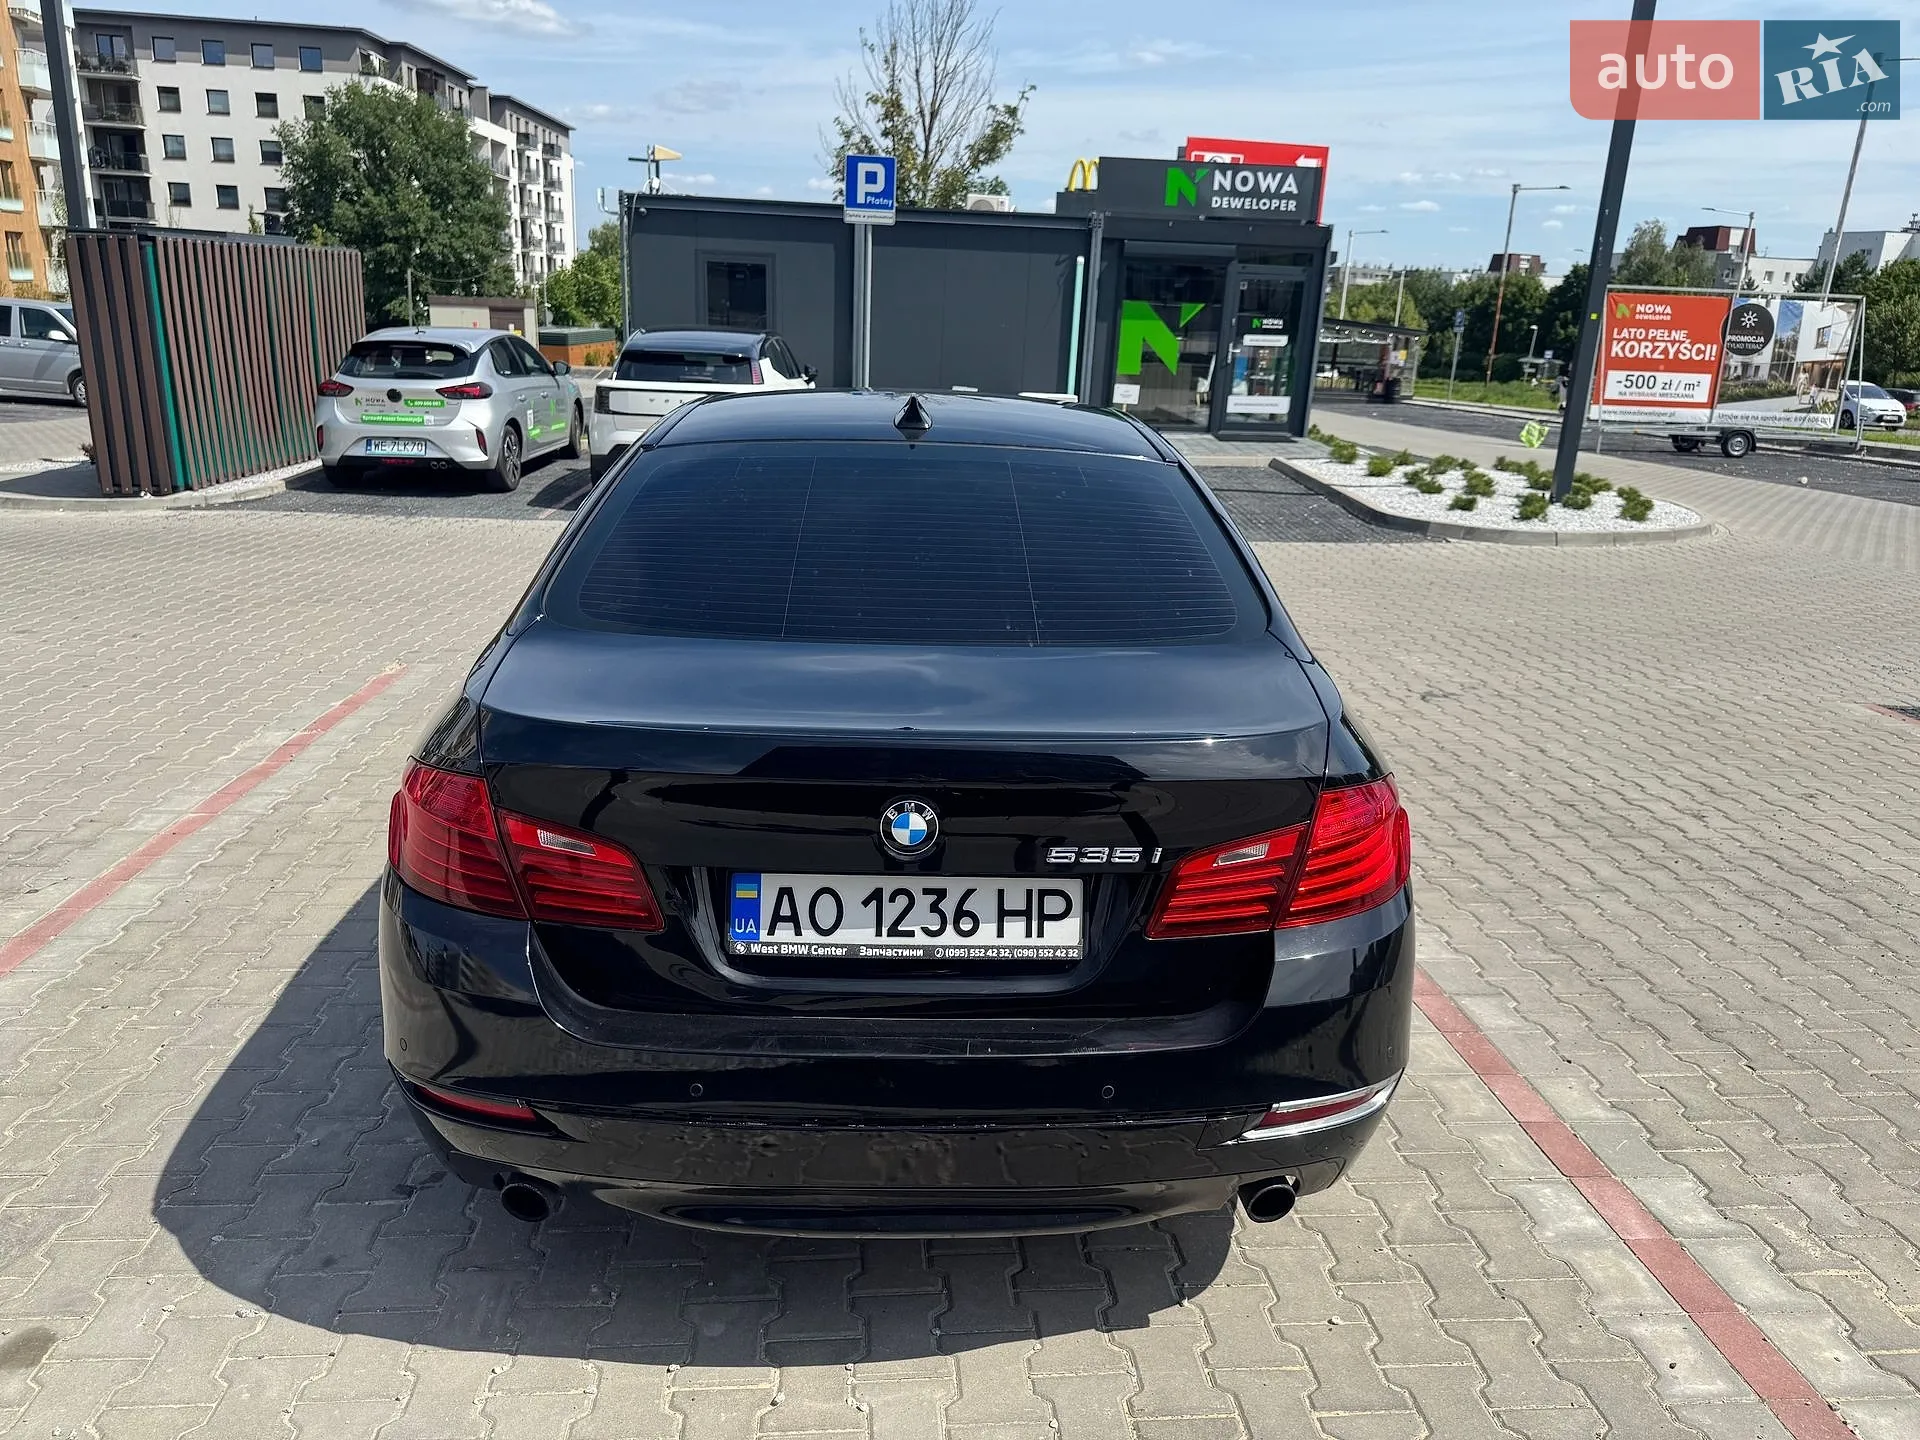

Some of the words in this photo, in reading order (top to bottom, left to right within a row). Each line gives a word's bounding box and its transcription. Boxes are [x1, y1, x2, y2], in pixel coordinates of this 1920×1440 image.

[857, 162, 886, 204] P
[1212, 169, 1299, 194] NOWA
[1211, 196, 1297, 212] DEWELOPER
[1636, 304, 1672, 314] NOWA
[1613, 327, 1646, 339] LATO
[1648, 329, 1689, 341] PEŁNE
[1727, 335, 1765, 343] PROMOCJA
[1610, 340, 1718, 361] KORZYŚCI!
[1616, 374, 1657, 390] -500
[1661, 379, 1673, 391] zł
[887, 803, 934, 820] BMW
[767, 886, 844, 938] AO
[861, 888, 982, 938] 1236
[997, 888, 1074, 938] HP
[735, 918, 757, 934] UA
[750, 943, 778, 954] West
[781, 944, 808, 955] BMW
[811, 945, 847, 956] Center
[859, 946, 923, 958] Запчастини
[945, 947, 968, 958] (095)
[970, 948, 985, 957] 552
[987, 948, 997, 957] 42
[1014, 948, 1037, 959] (096)
[1038, 948, 1053, 958] 552
[1055, 948, 1067, 958] 42
[1067, 948, 1079, 958] 32
